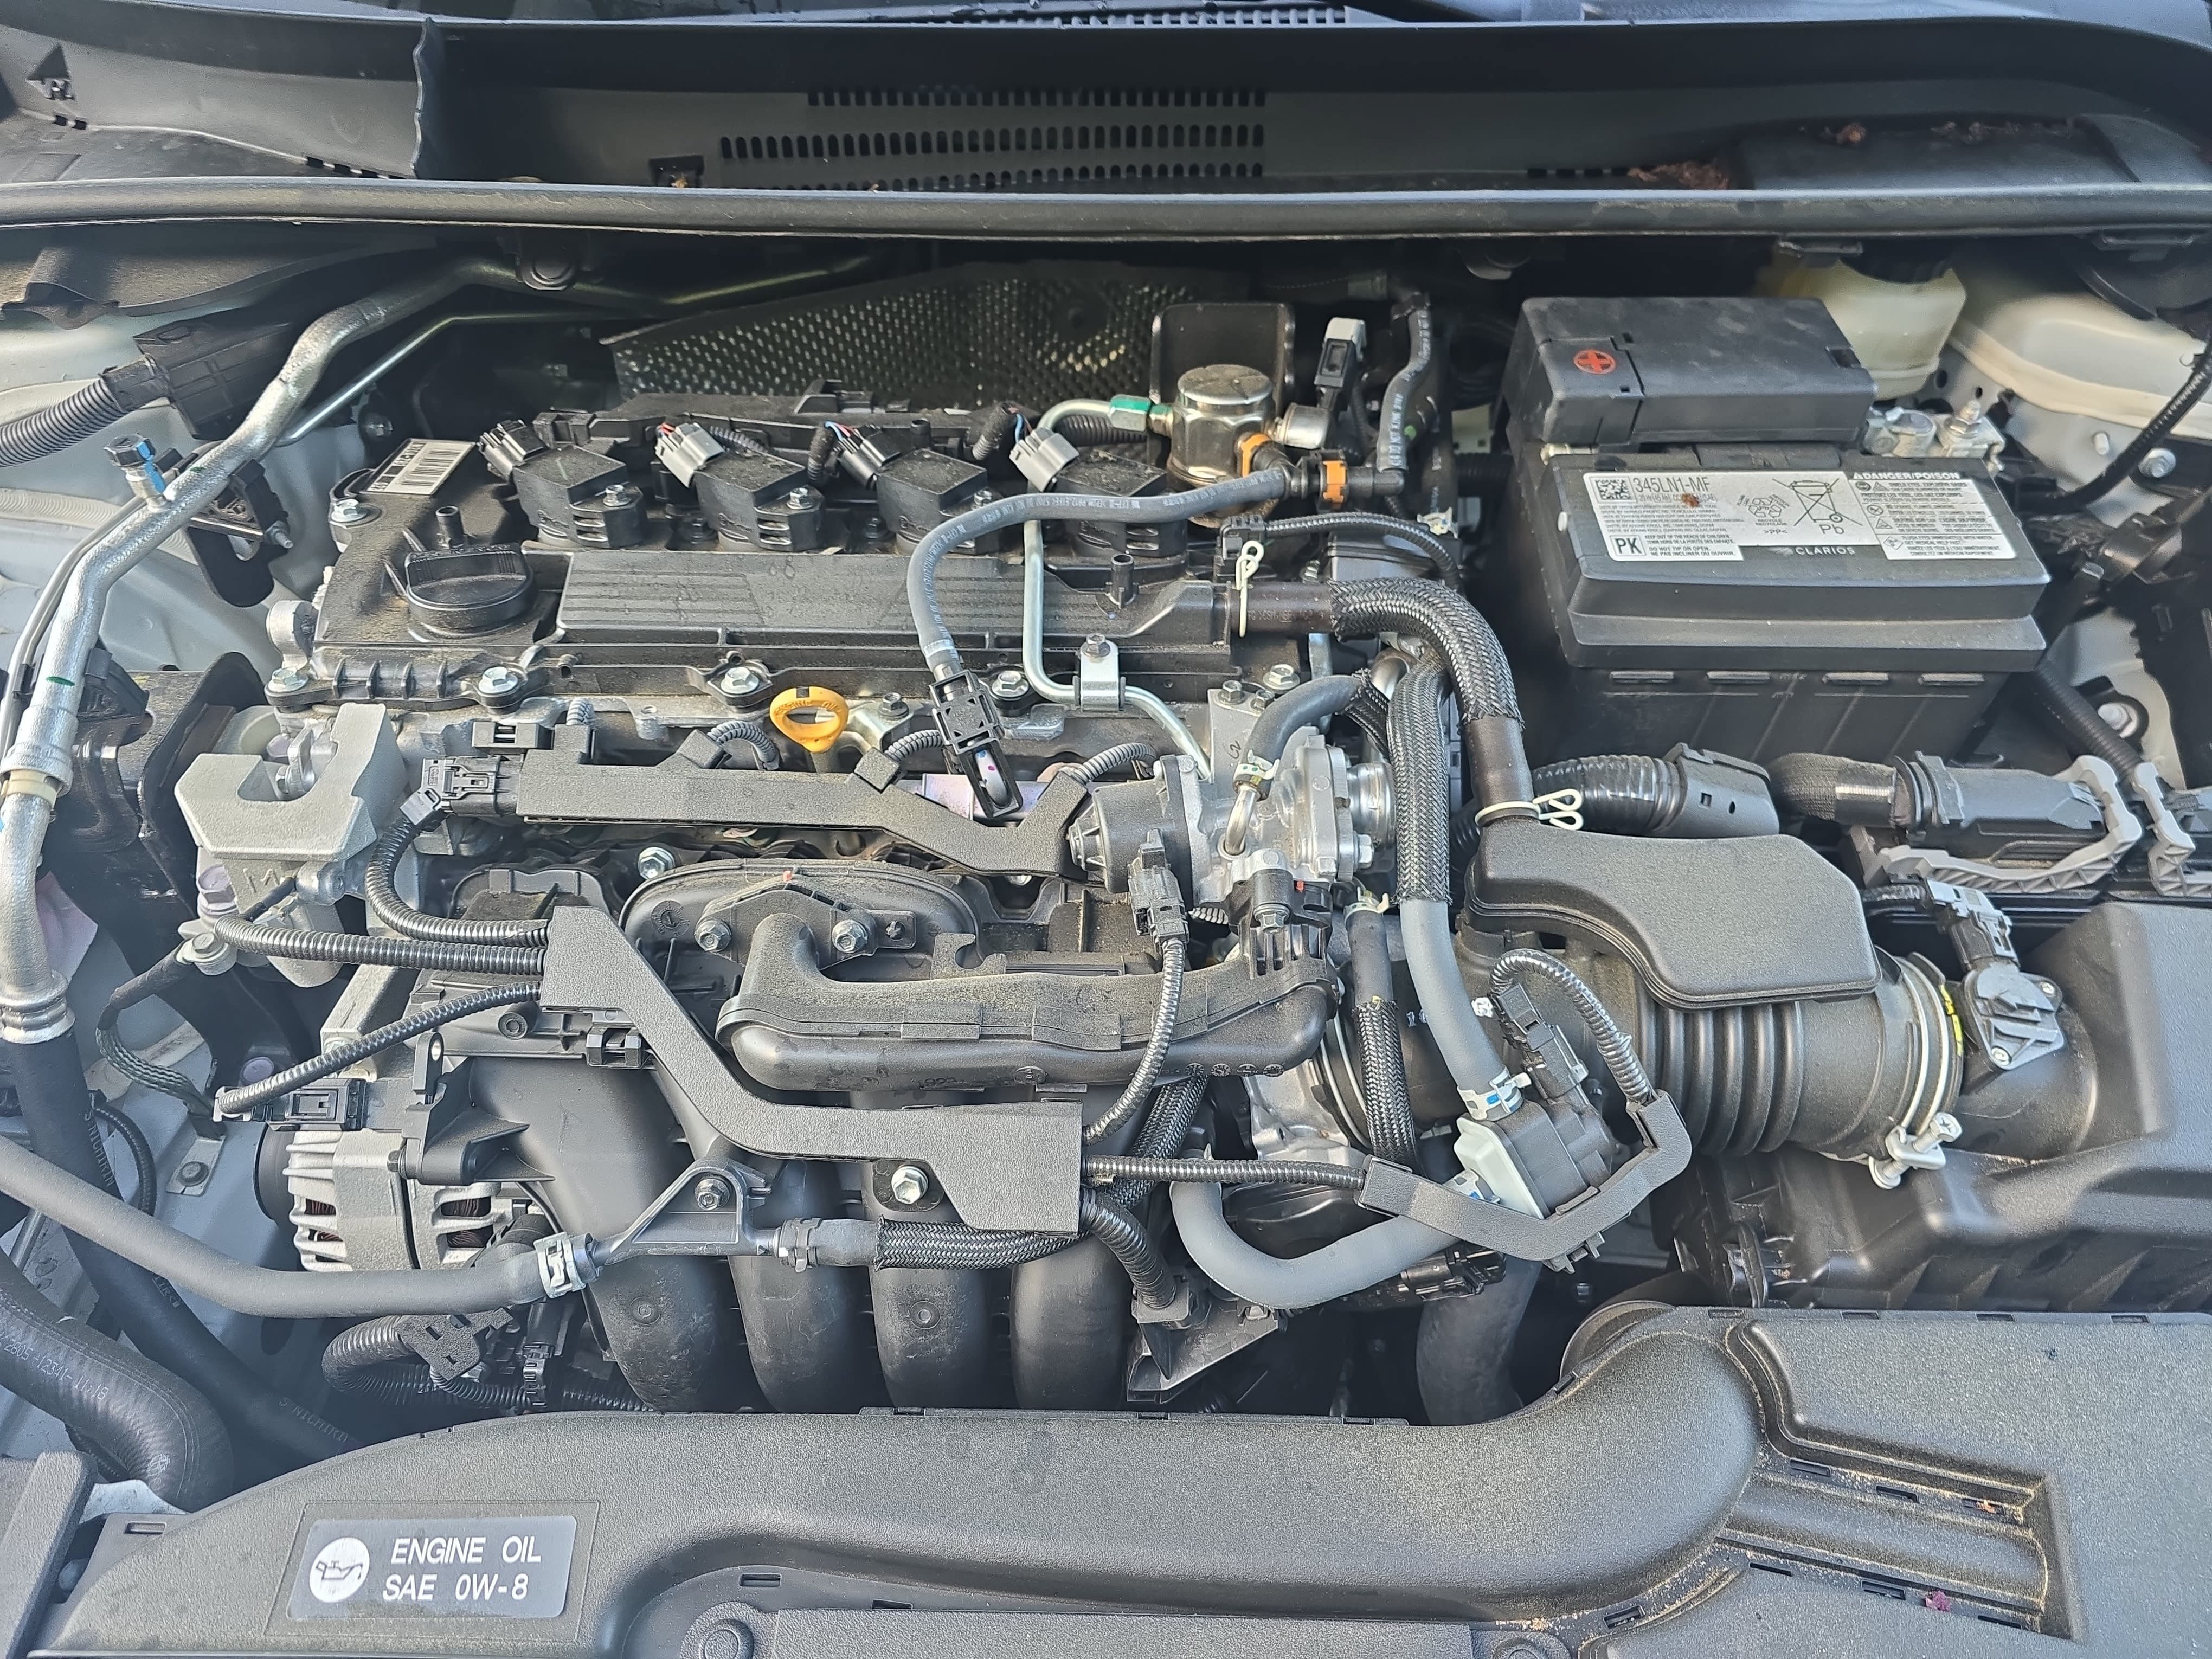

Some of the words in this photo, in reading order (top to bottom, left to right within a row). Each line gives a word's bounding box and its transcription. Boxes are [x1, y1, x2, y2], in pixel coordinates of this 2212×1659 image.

[1633, 477, 1710, 493] 345LN1-MF
[1819, 524, 1844, 535] Pb
[1615, 537, 1642, 554] PK
[1795, 547, 1855, 555] CLARIOS
[87, 1127, 115, 1187] NICHIRIN
[390, 1536, 486, 1564] ENGINE
[501, 1535, 542, 1563] OIL
[382, 1574, 437, 1601] SAE
[454, 1573, 529, 1600] 0W-8
